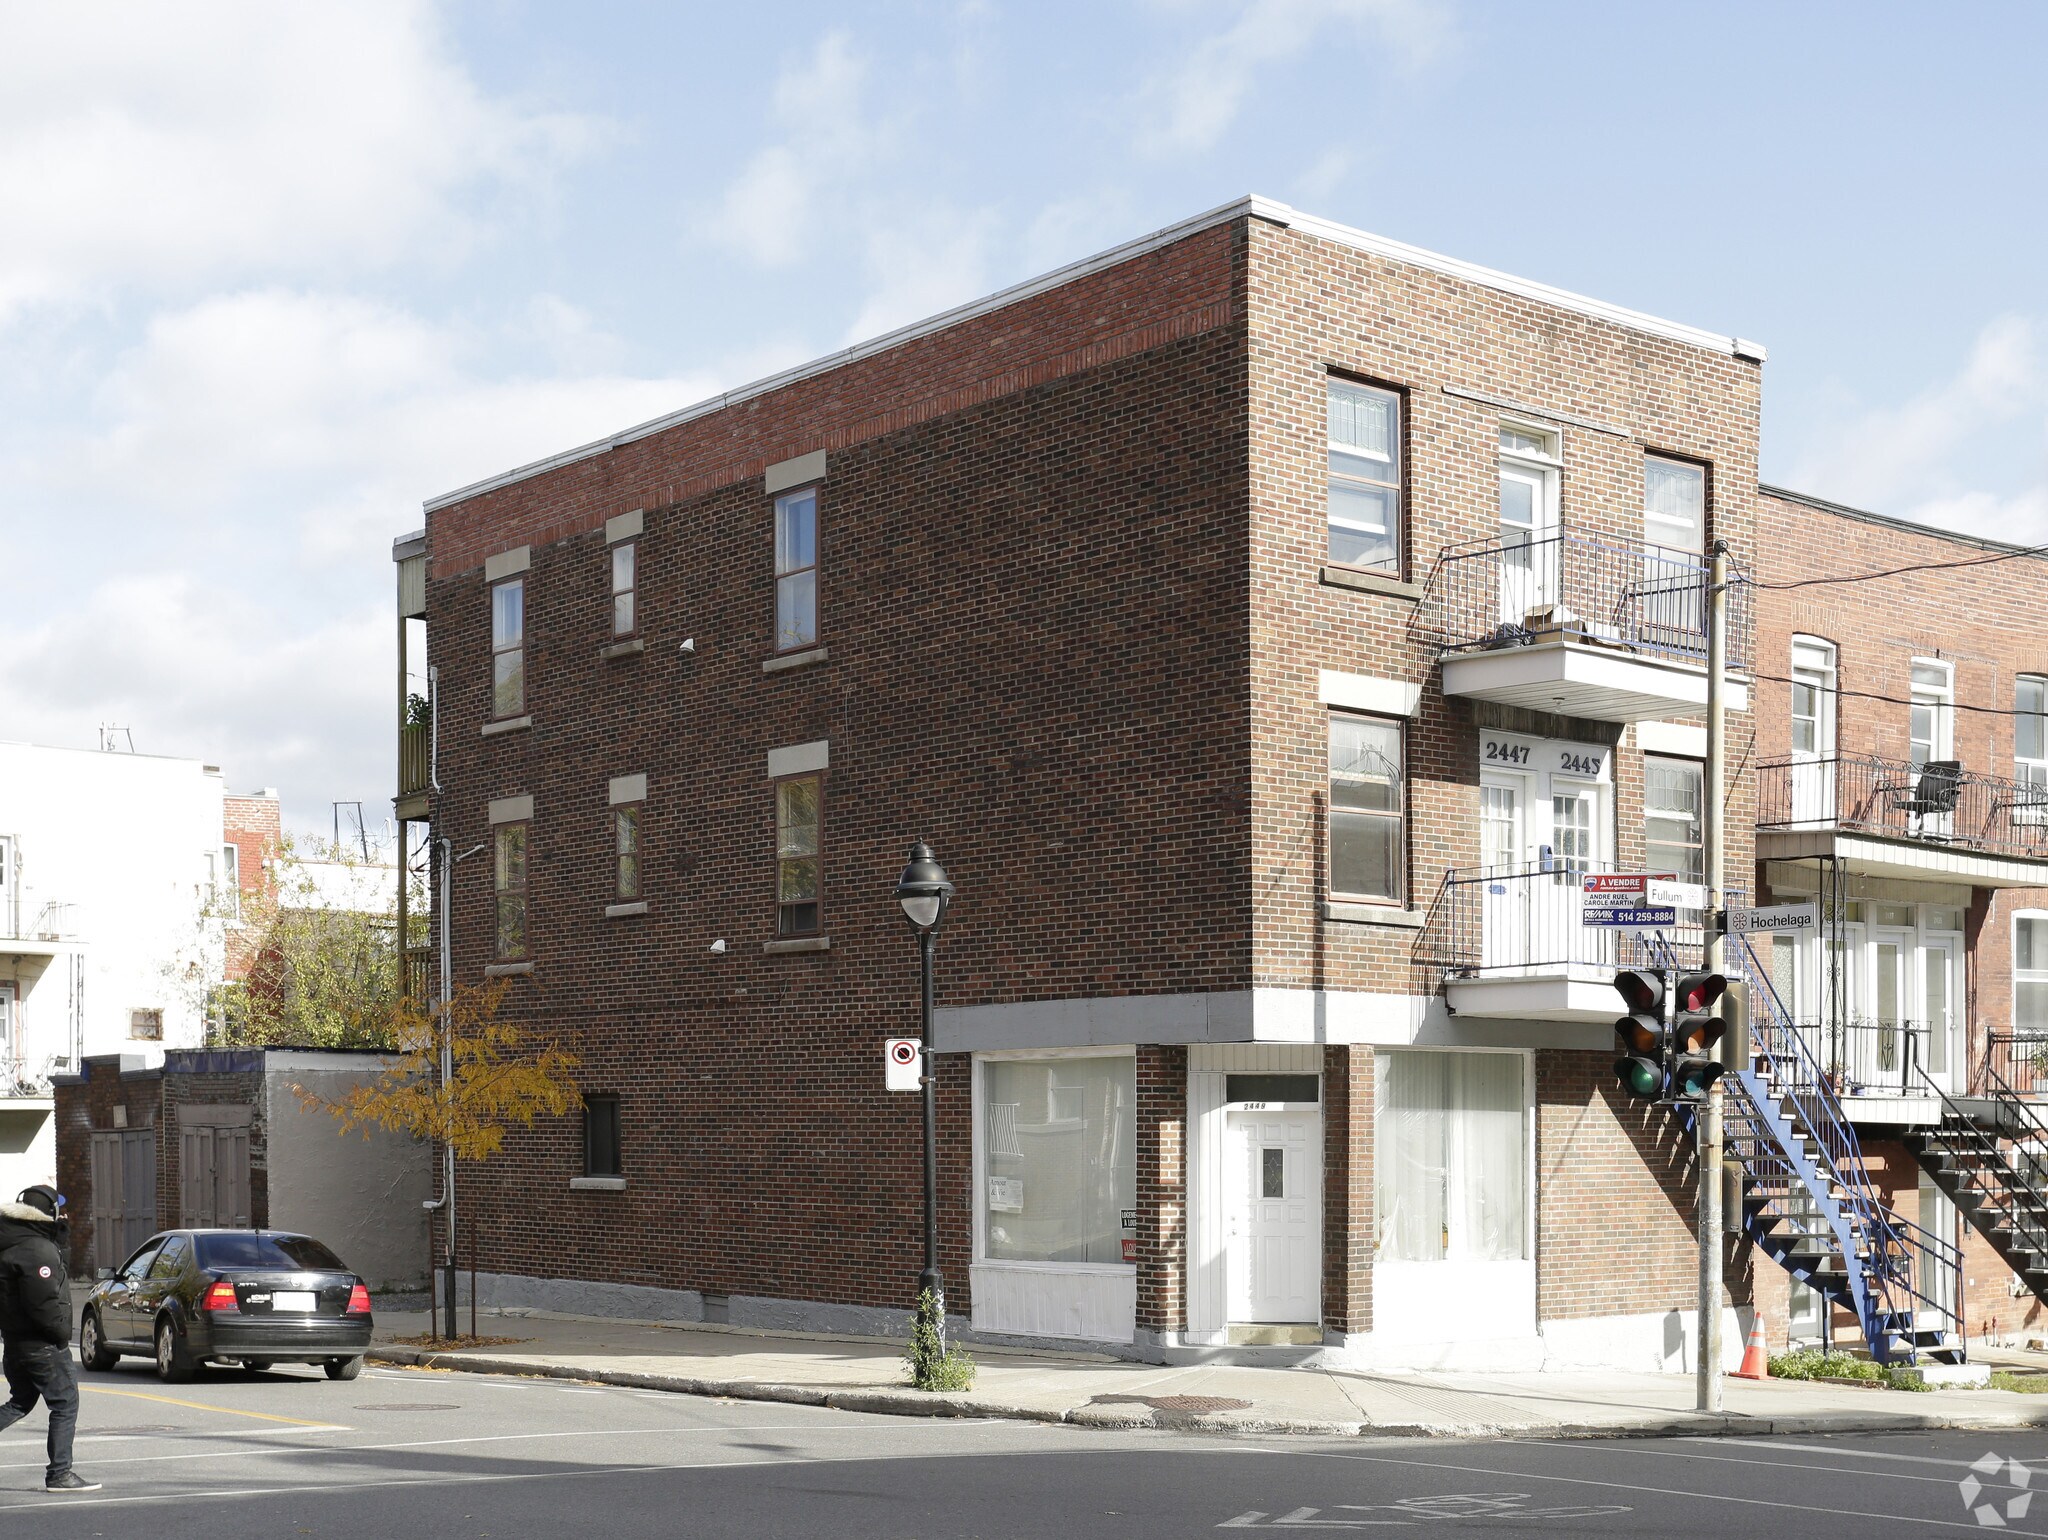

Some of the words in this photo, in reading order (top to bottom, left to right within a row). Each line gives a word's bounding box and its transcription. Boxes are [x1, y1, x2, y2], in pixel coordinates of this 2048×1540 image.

[1486, 742, 1531, 764] 2447
[1608, 878, 1640, 886] VENDRE
[1652, 888, 1683, 902] Fullum
[1584, 910, 1615, 919] RE/MAX
[1618, 912, 1634, 922] 514
[1636, 911, 1674, 922] 259-8884
[1751, 914, 1811, 928] Hochelaga
